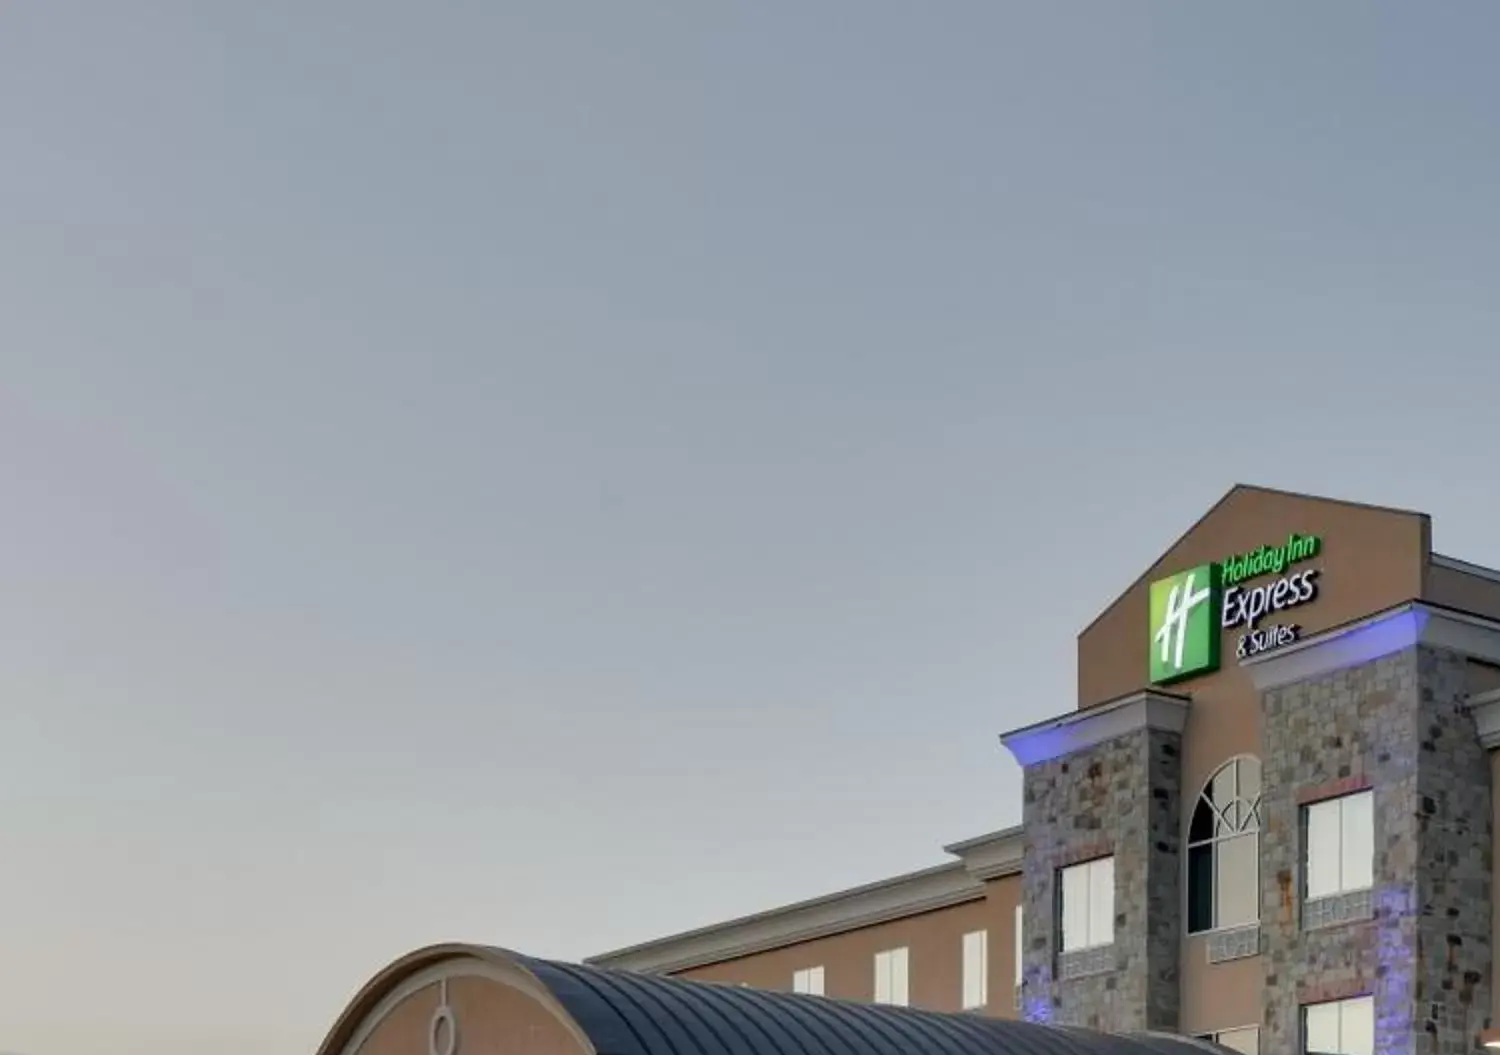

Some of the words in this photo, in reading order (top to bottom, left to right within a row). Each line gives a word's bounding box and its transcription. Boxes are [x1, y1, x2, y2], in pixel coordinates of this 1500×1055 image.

[1221, 546, 1286, 585] Holiday
[1287, 534, 1315, 565] Inn
[1221, 569, 1314, 628] Express
[1236, 633, 1249, 657] &
[1250, 624, 1295, 653] Suites
